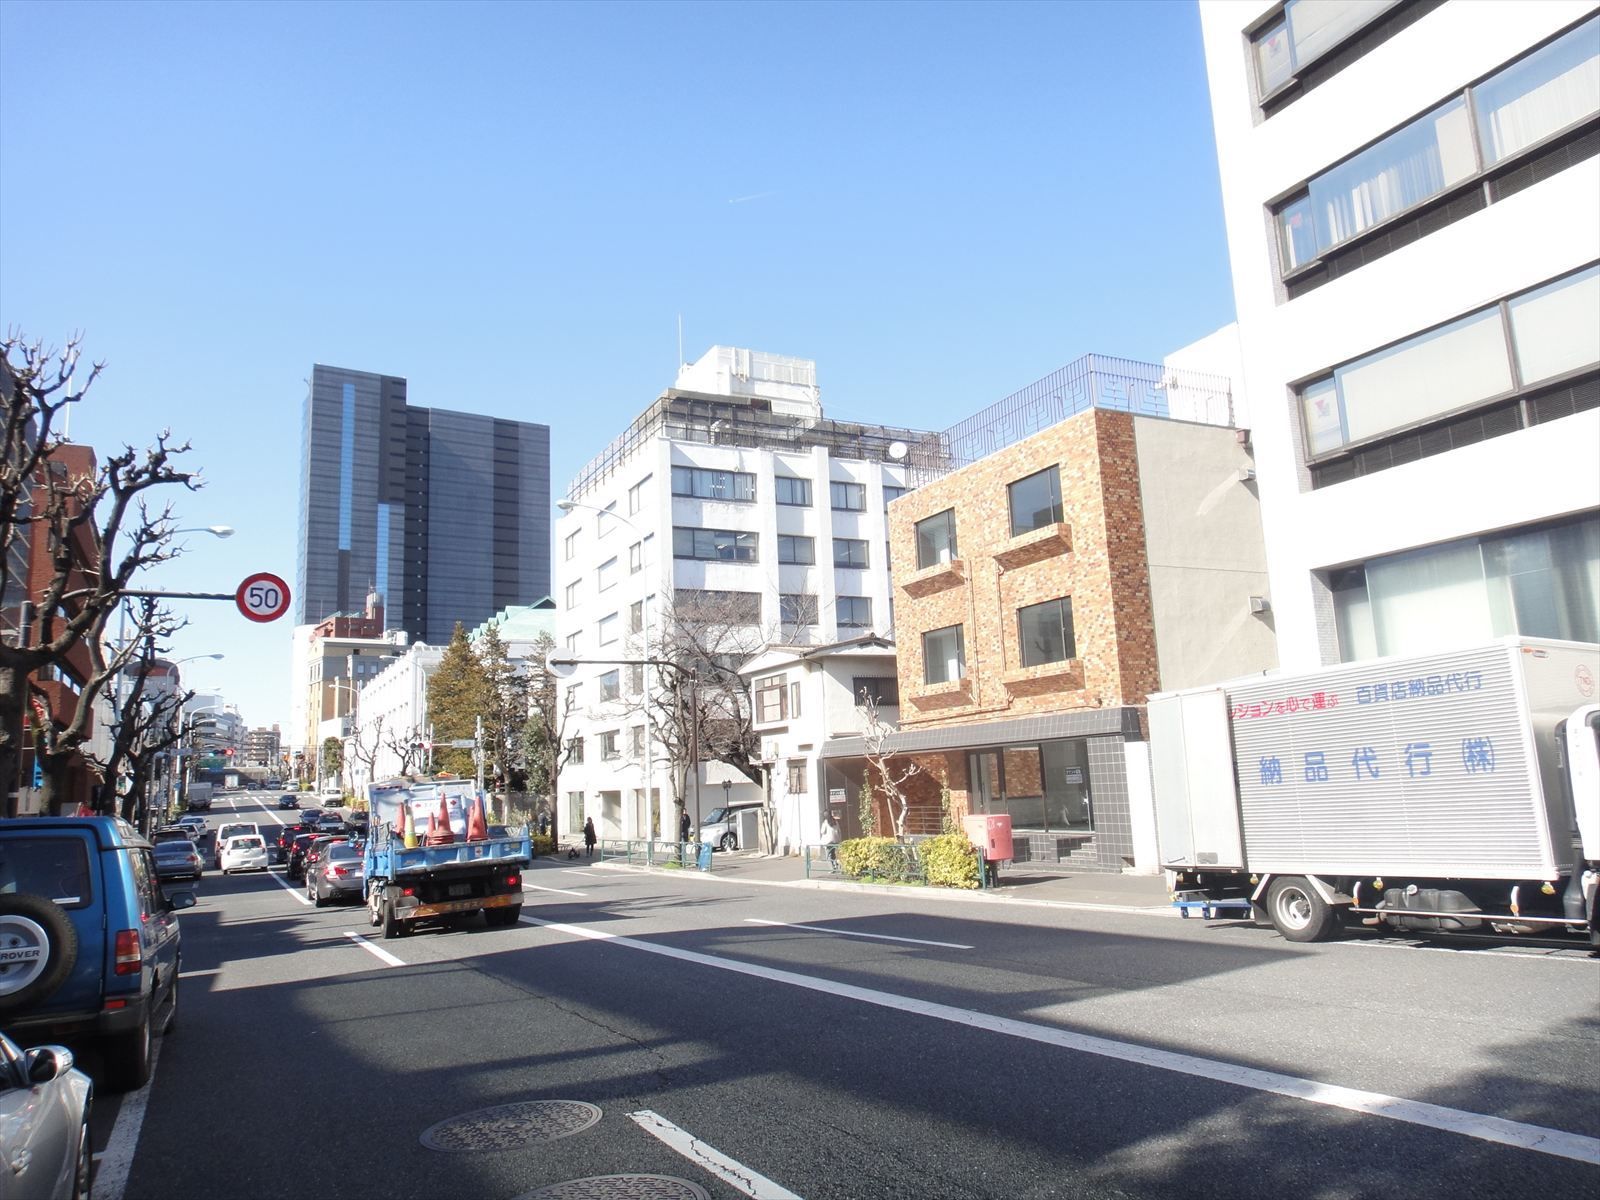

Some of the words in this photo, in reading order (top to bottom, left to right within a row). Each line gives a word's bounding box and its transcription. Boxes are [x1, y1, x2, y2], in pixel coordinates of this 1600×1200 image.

[250, 587, 279, 608] 50
[1355, 670, 1483, 705] 百貨店納品代行
[1, 950, 41, 960] ROVER
